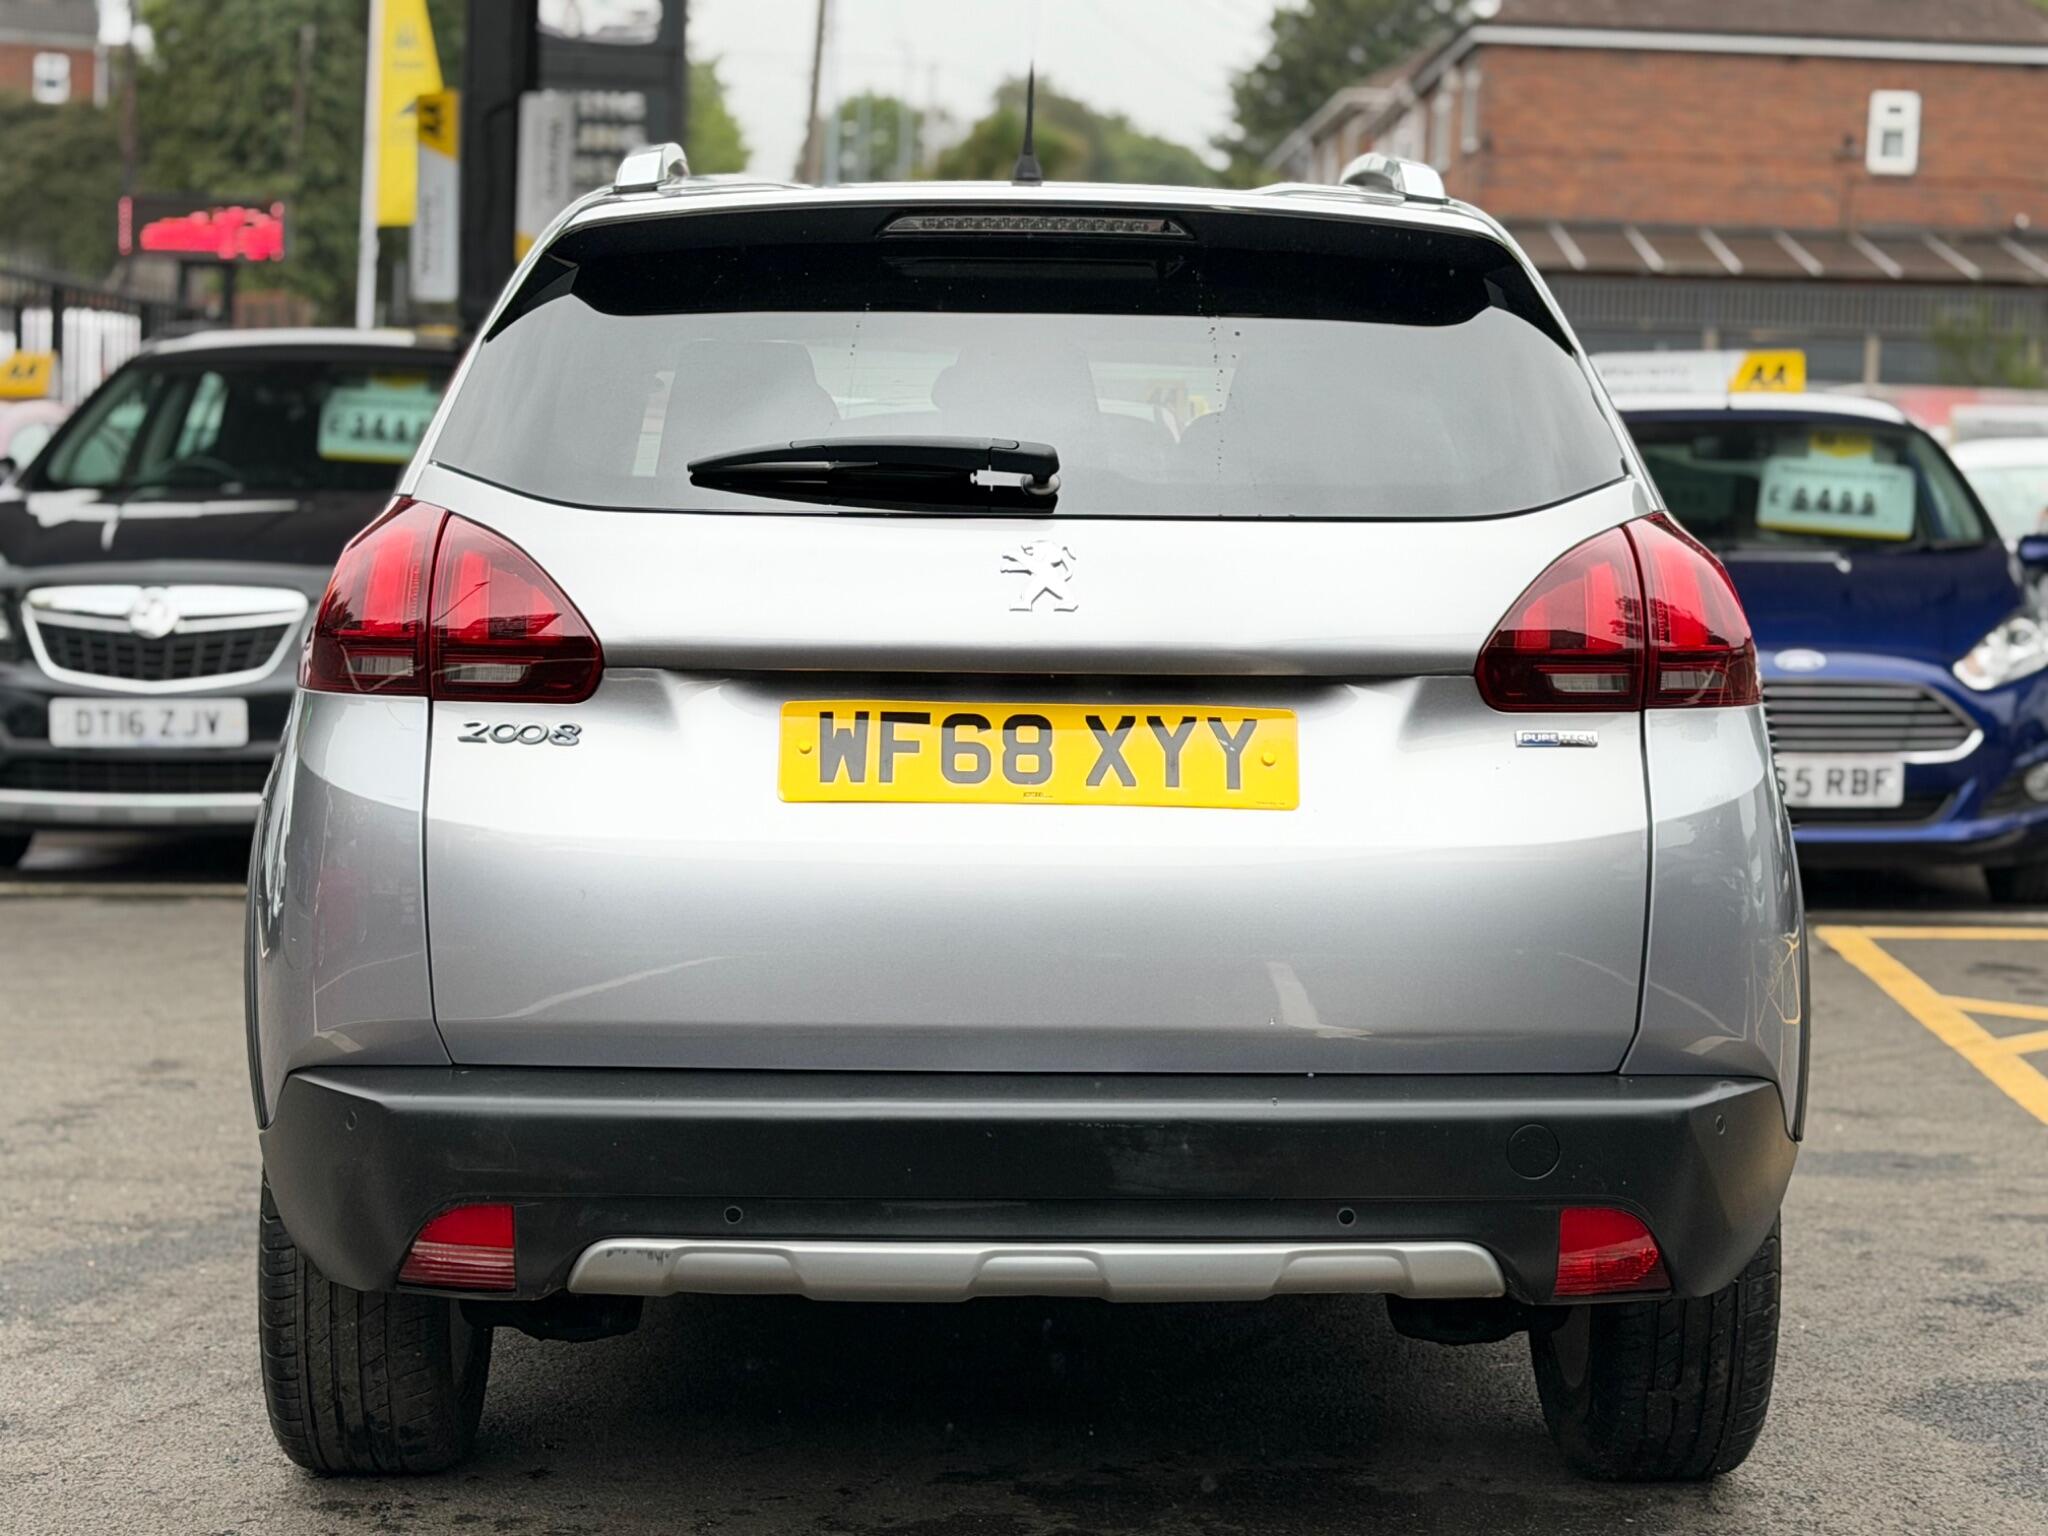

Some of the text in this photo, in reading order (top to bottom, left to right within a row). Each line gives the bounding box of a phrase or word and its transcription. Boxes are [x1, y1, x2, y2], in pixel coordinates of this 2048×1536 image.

[76, 709, 220, 738] DT16 ZJV
[457, 722, 582, 746] 2008
[818, 710, 1259, 790] WF68 XYY
[1826, 767, 1892, 797] RBF
